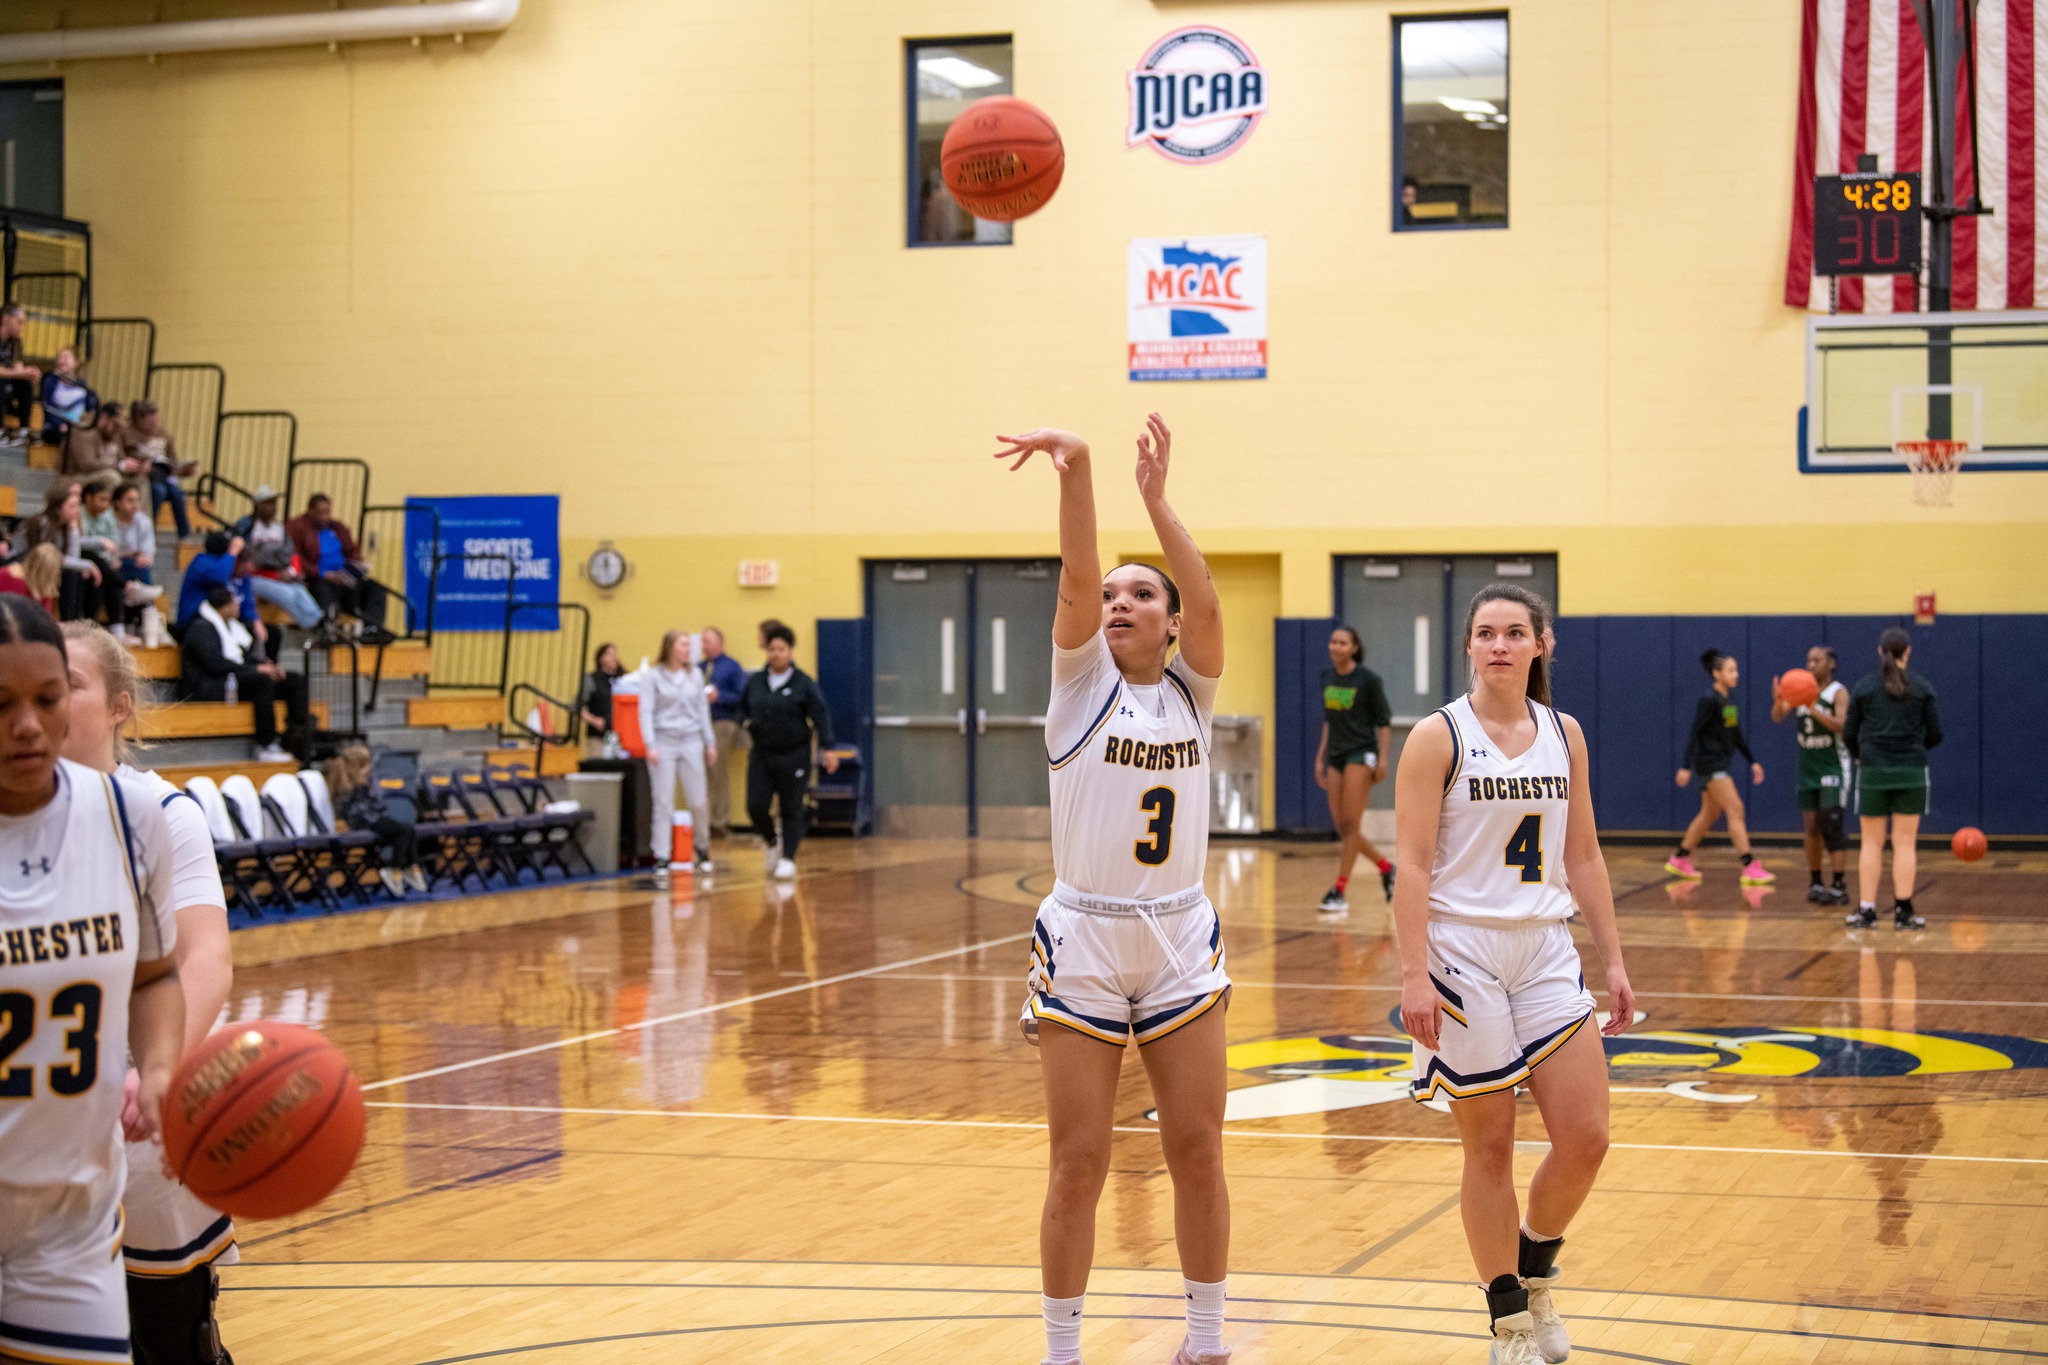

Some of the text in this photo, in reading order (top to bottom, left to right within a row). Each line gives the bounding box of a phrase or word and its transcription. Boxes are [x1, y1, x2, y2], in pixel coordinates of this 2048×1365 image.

[1134, 71, 1263, 136] NJCAA
[1843, 180, 1911, 212] 4:28
[1838, 213, 1899, 265] 30
[1147, 267, 1243, 302] MCAC
[463, 537, 533, 560] SPORTS
[1468, 776, 1569, 801] ROCHESTER
[1133, 785, 1177, 867] 3
[1504, 812, 1544, 885] 4
[0, 977, 104, 1098] 23
